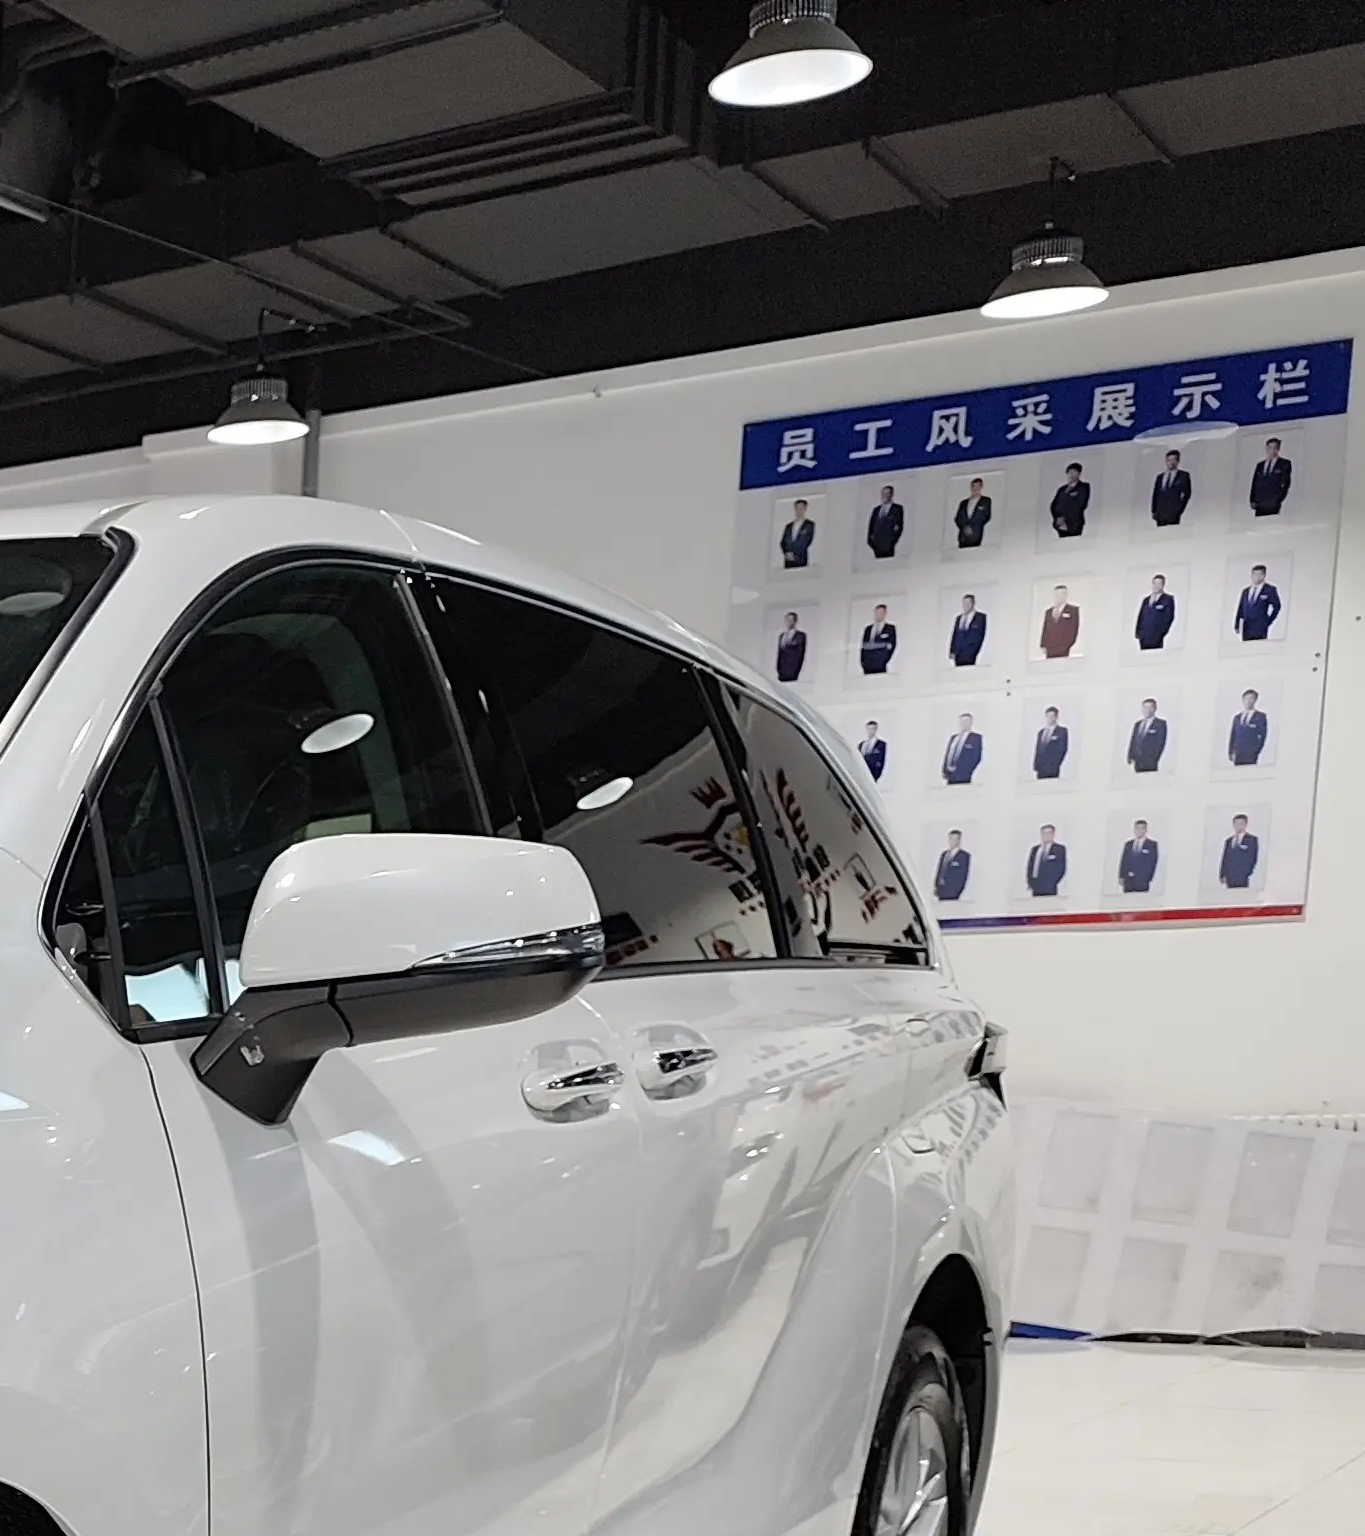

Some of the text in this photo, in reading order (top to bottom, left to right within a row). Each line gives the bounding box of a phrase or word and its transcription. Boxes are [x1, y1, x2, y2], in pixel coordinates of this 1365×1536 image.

[776, 362, 1312, 474] 员工风采展示栏
